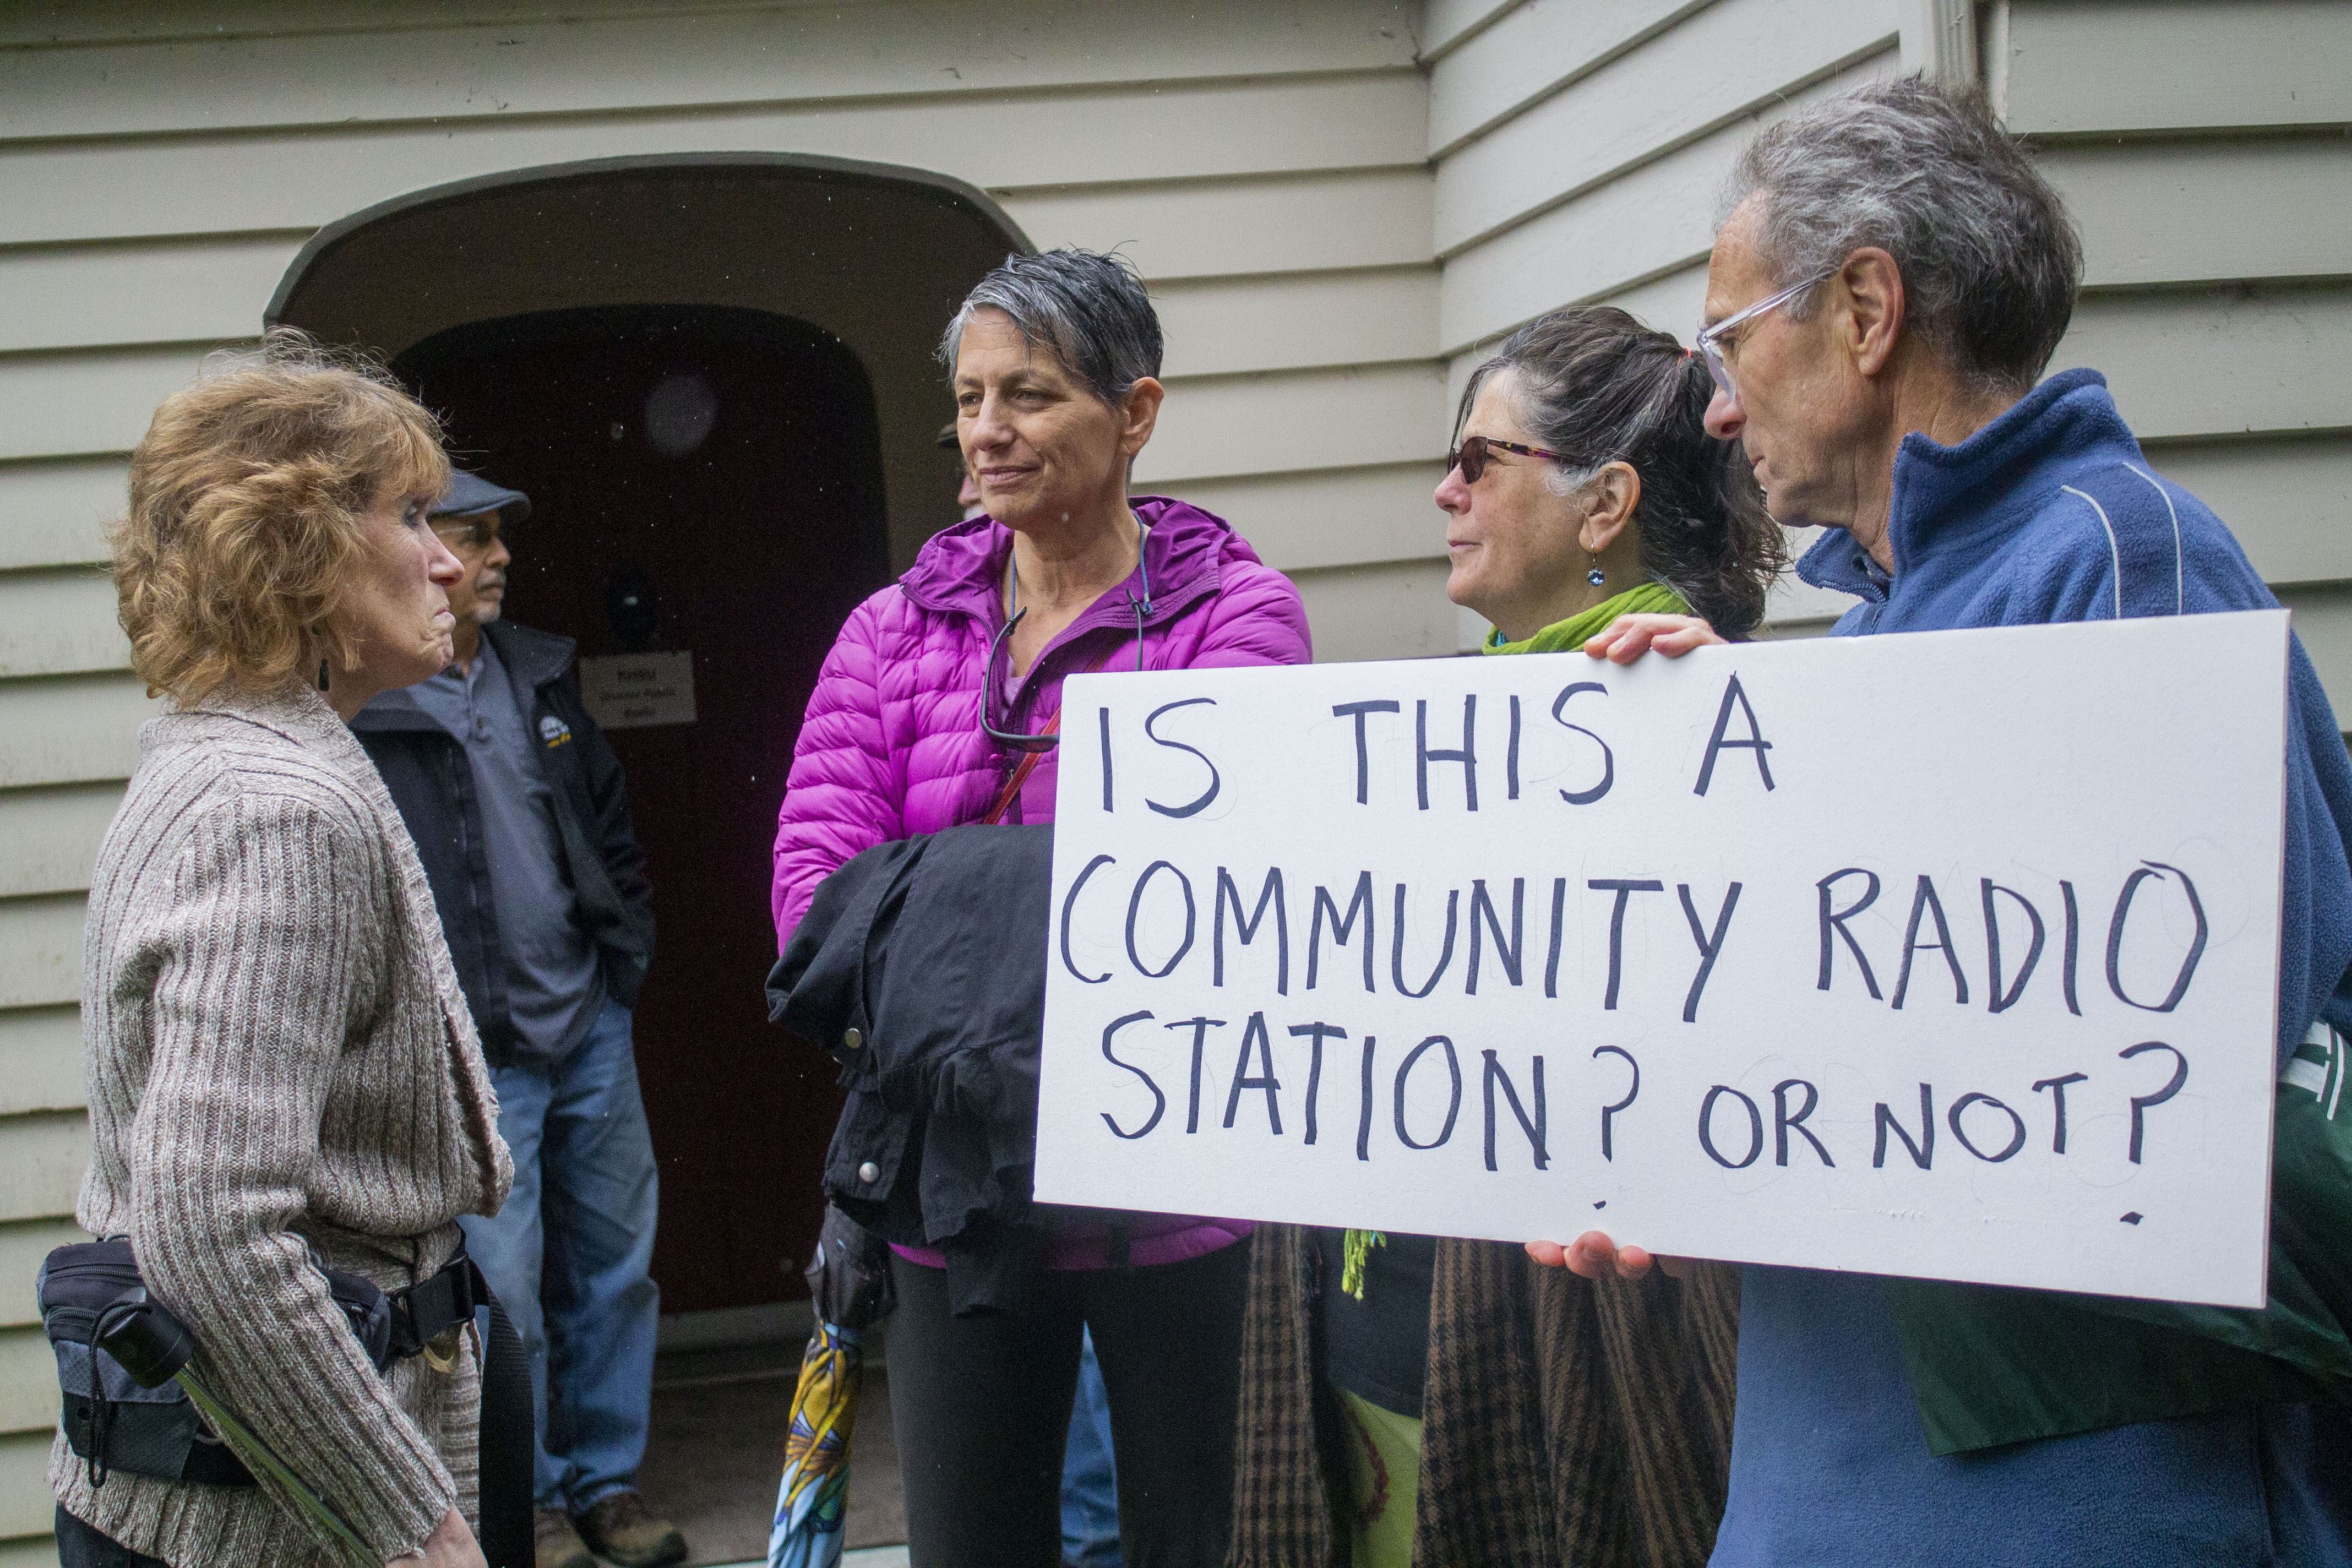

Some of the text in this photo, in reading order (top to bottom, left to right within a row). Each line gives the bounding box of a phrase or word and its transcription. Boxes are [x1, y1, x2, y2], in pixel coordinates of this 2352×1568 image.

[1099, 671, 1776, 819] IS THIS A
[1060, 854, 2208, 1023] COMMUNITY RADIO
[1101, 1010, 2188, 1226] STATION? OR NOT?
